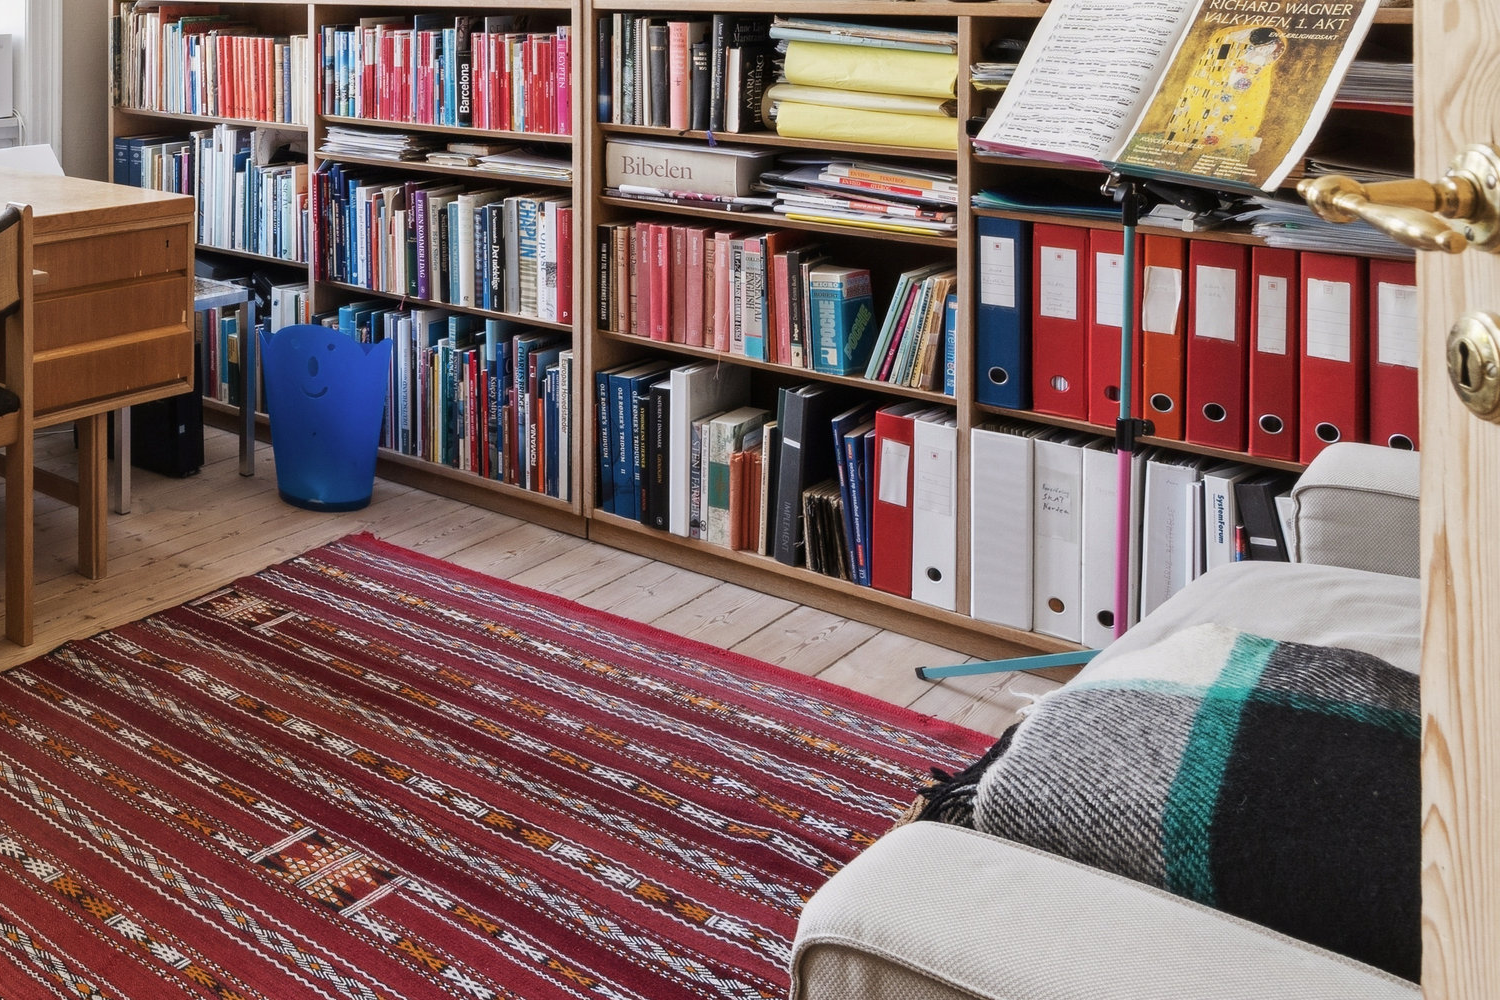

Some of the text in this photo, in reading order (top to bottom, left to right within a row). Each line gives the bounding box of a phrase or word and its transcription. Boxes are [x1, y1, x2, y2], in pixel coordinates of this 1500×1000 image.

[1204, 12, 1349, 30] VALKYRIEN, 1. AKT
[1286, 3, 1353, 16] WAGNER
[460, 64, 469, 113] Barcelona
[746, 70, 755, 109] MARIA
[754, 55, 764, 123] HELLEBERG
[621, 155, 692, 179] Bibelen
[519, 200, 537, 259] CHAPLIN
[491, 259, 500, 290] udelelige
[746, 272, 754, 309] ENGLISH
[819, 300, 836, 347] POCHE
[844, 304, 872, 360] POCHE
[560, 359, 568, 387] Europas
[692, 440, 700, 468] STEN
[691, 477, 700, 518] FARVER
[782, 501, 791, 552] IMPLEMENT
[1216, 494, 1225, 544] SystemForum
